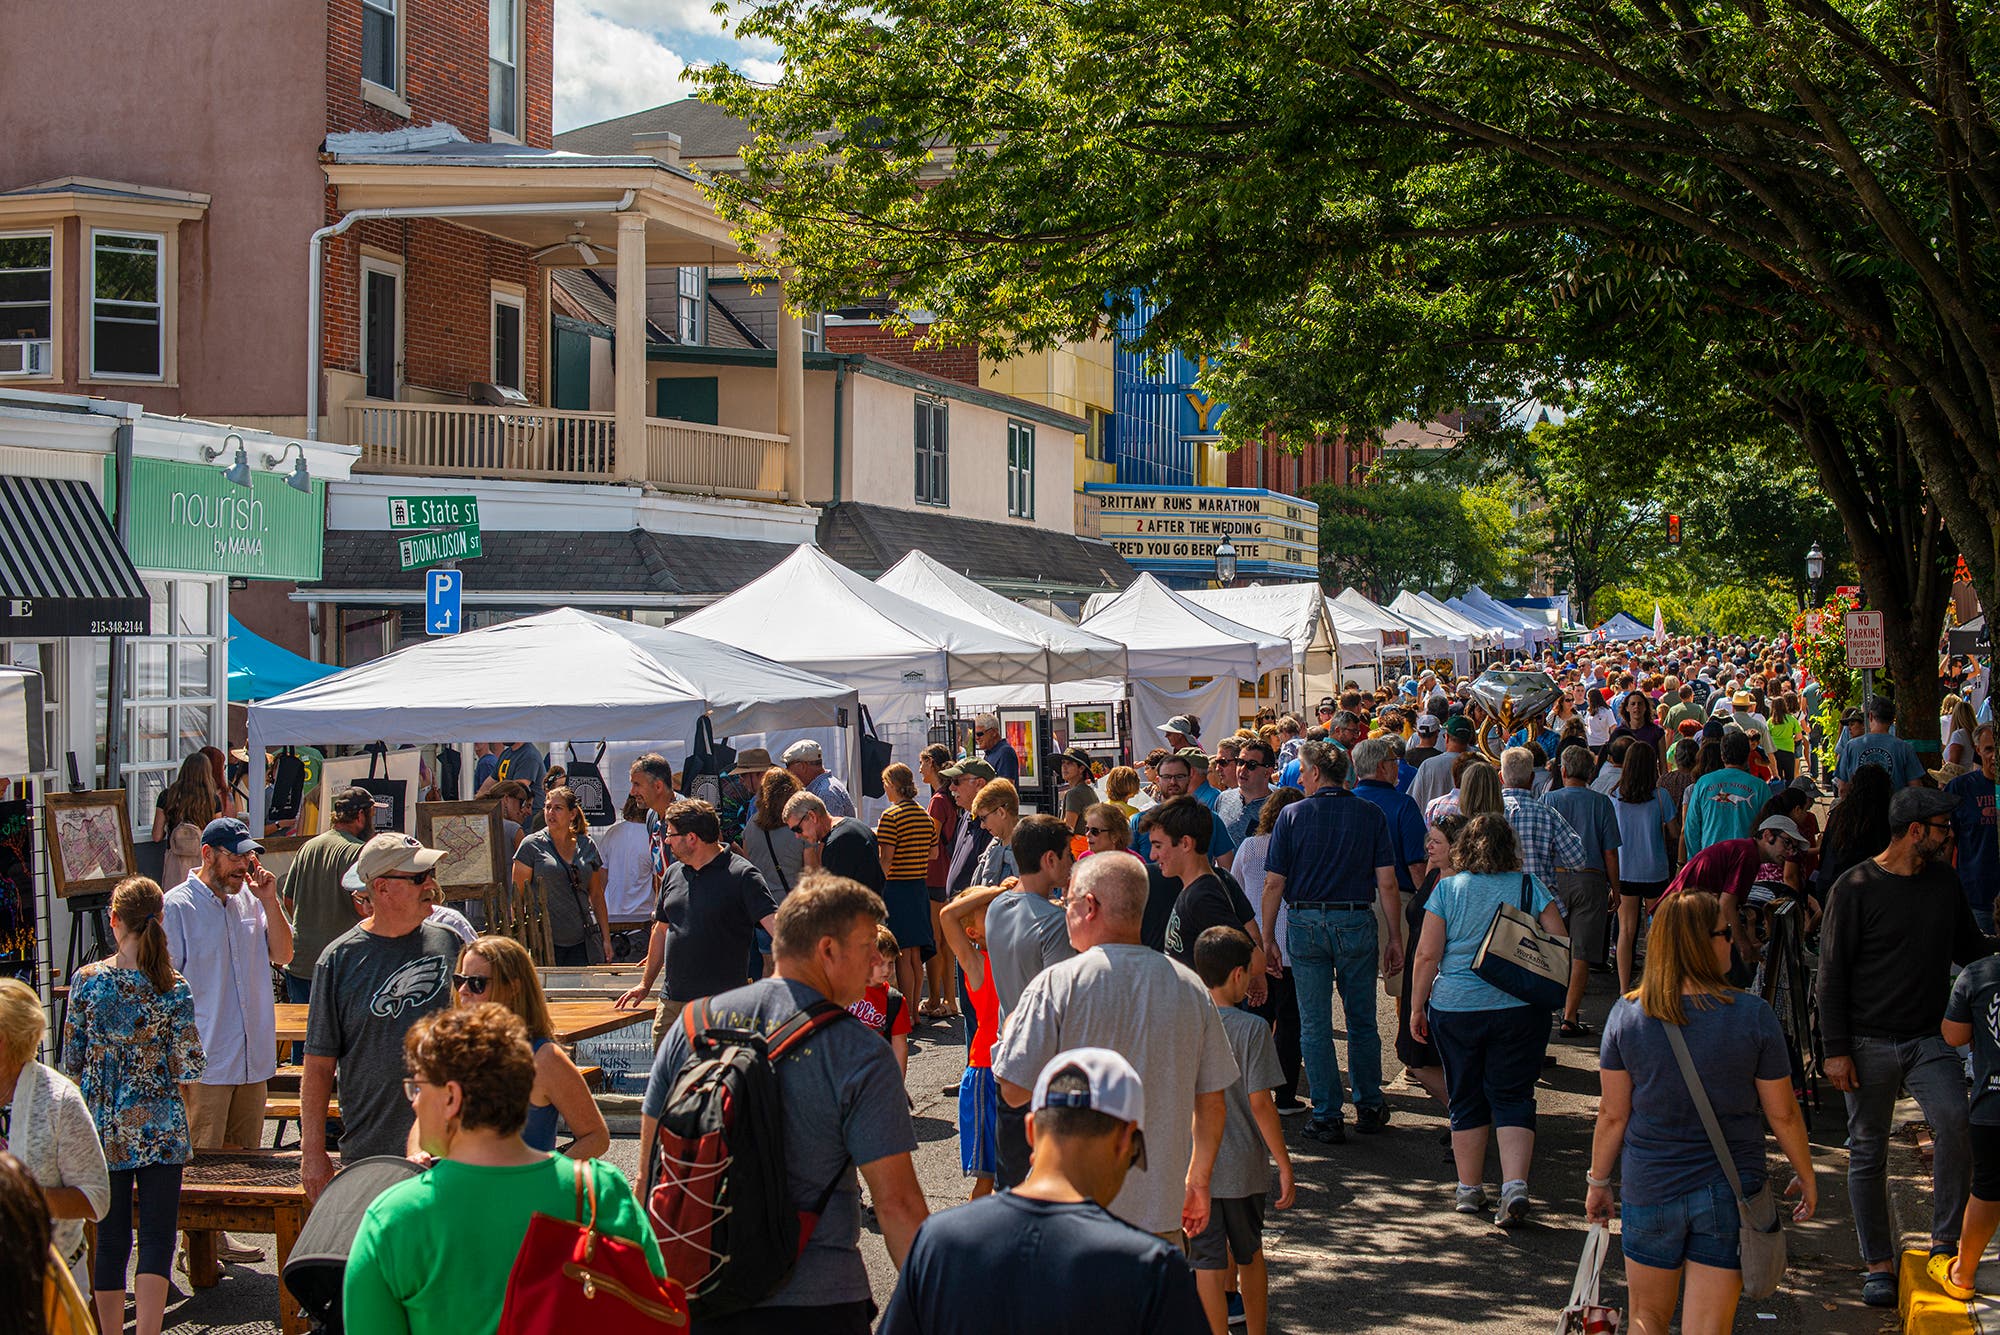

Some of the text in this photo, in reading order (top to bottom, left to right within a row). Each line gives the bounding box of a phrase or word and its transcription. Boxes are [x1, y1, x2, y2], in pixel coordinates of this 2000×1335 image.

[409, 499, 478, 525] E State ST
[1099, 495, 1260, 513] BRITTANY RUNS MARATHON
[1136, 519, 1144, 532] 2
[1147, 519, 1185, 533] AFTER
[1190, 520, 1210, 534] THE
[213, 534, 262, 559] by MAMA
[411, 530, 480, 564] DONALDSON ST
[1147, 543, 1170, 556] YOU
[1173, 543, 1188, 556] GO
[434, 574, 453, 605] P
[8, 599, 33, 617] E
[91, 620, 144, 633] 215-348-2144
[1857, 615, 1869, 626] NO
[1849, 627, 1880, 639] PARKING
[1849, 640, 1879, 648] THURSDAY
